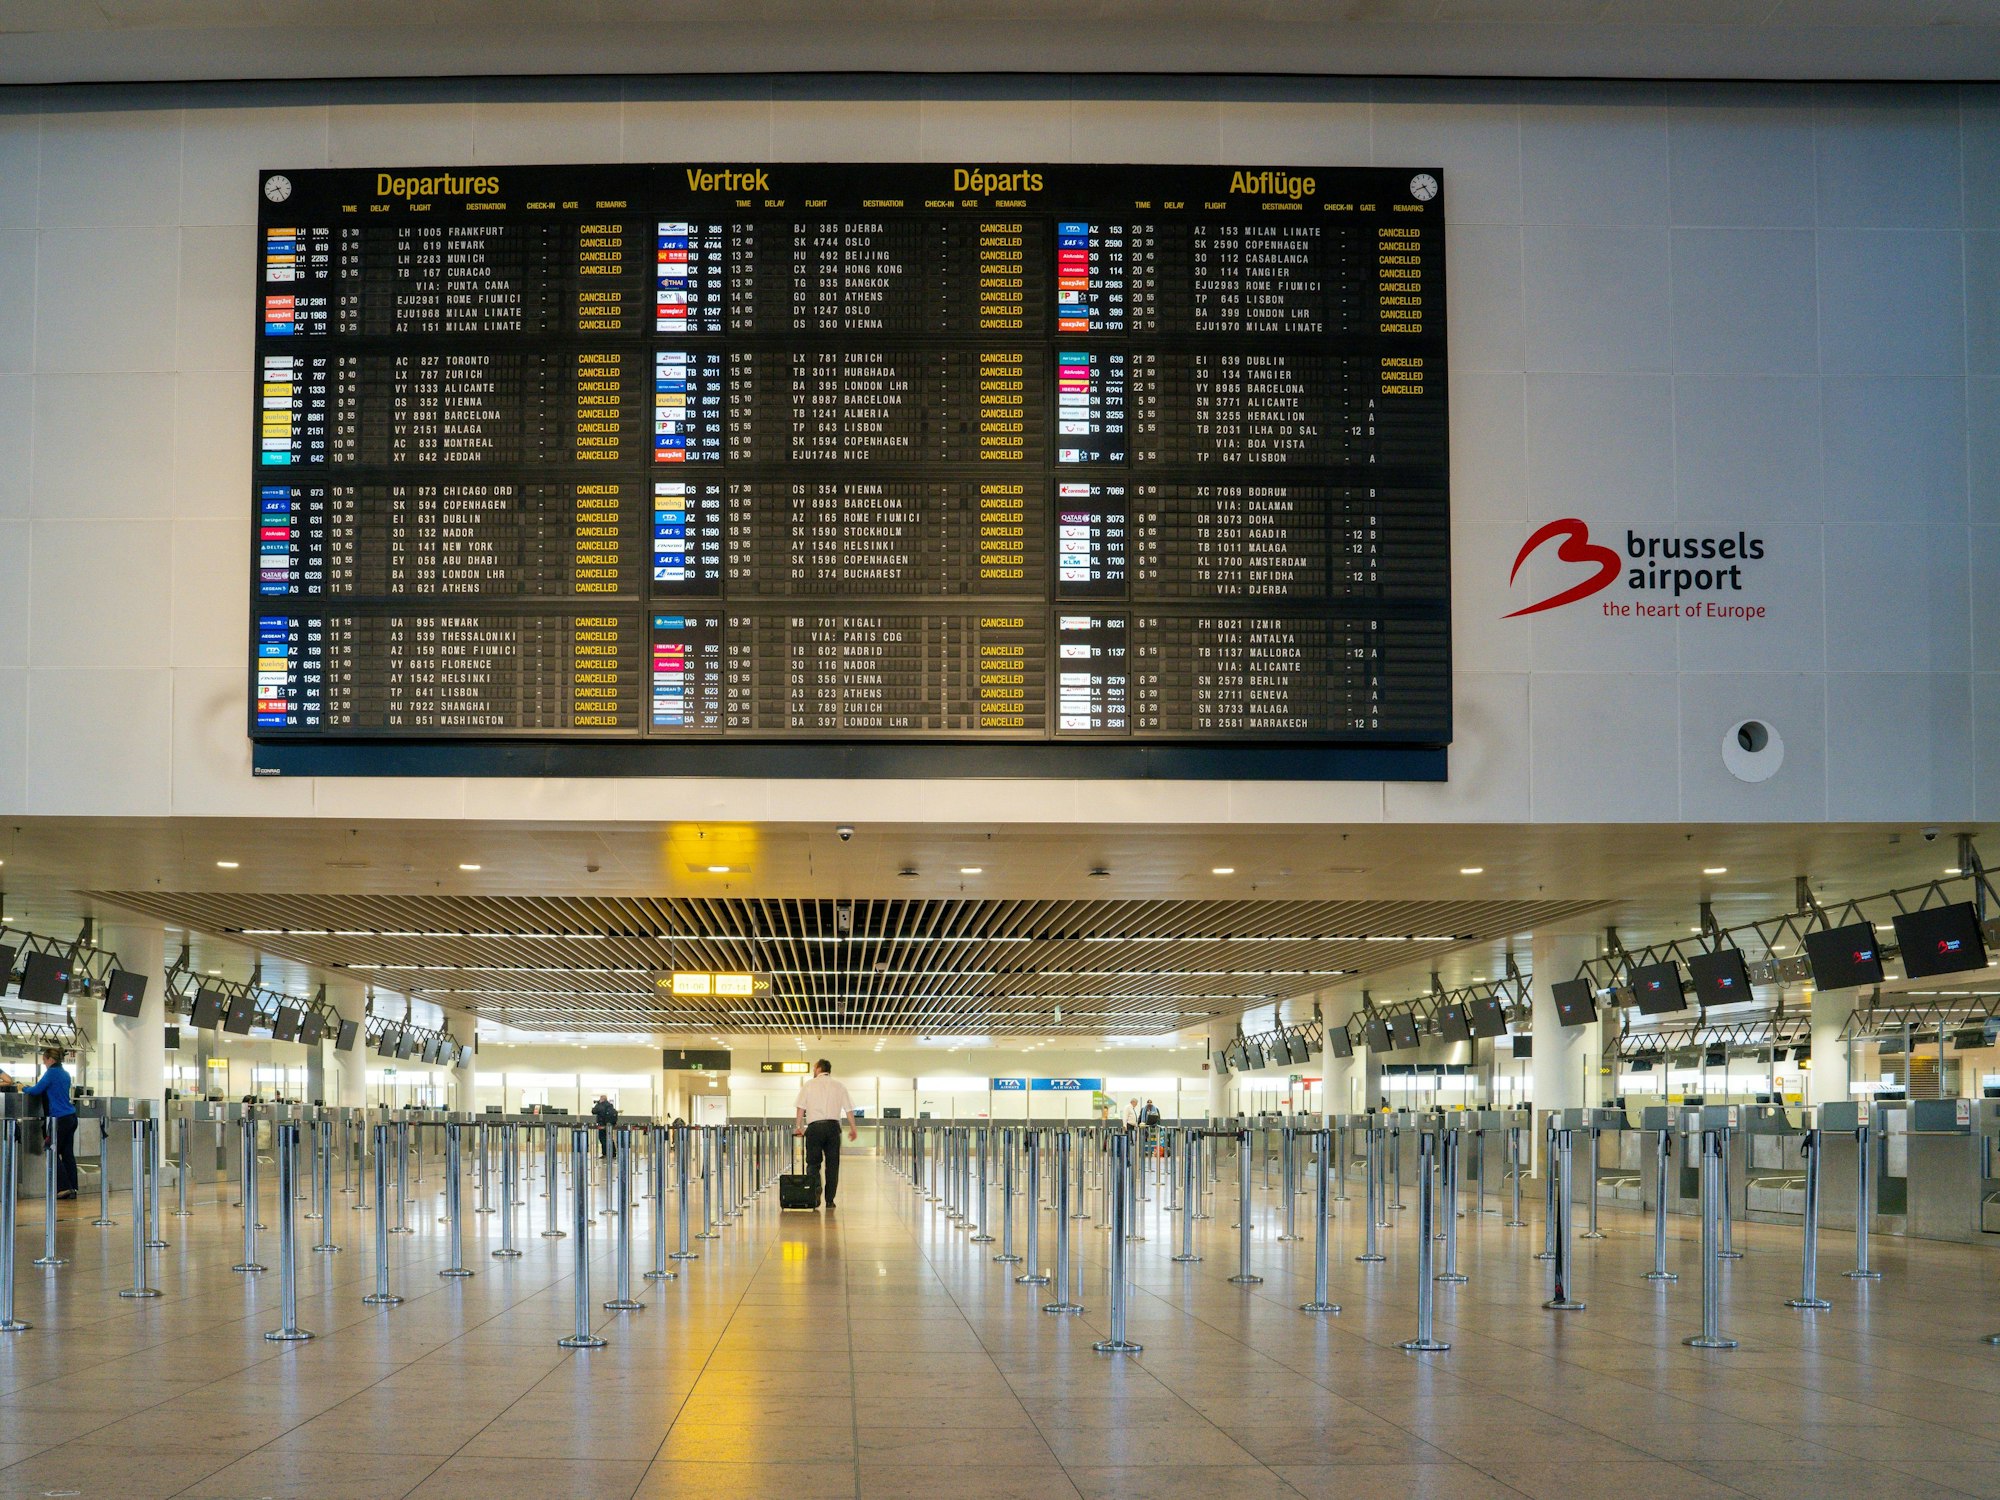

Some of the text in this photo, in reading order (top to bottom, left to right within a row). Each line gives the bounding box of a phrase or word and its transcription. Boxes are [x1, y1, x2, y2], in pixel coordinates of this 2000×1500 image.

[687, 169, 769, 191] Vertrek
[954, 169, 1043, 196] Départs
[378, 173, 499, 200] Departures
[1230, 171, 1315, 199] Abflüge
[399, 225, 622, 237] LH 1005 FRANKFURT CANCELLED
[820, 224, 1022, 233] 385 DJERBA CANCELLED
[1245, 227, 1420, 237] MILAN LINATE CANCELLED
[448, 241, 484, 249] NEWARK
[1195, 240, 1308, 249] SK 2590 COPENHAGEN
[448, 254, 484, 263] MUNICH
[846, 251, 889, 260] BEIJING
[1246, 254, 1308, 263] CASABLANCA
[448, 267, 490, 276] CURACAO
[845, 265, 902, 273] HONG KONG
[1246, 268, 1289, 276] TANGIER
[448, 281, 509, 290] PUNTA CANA
[845, 279, 889, 287] BANGKOK
[1246, 281, 1320, 291] ROME FIUMICI
[398, 293, 621, 304] EJU2981 ROME FIUMICI CANCELLED
[845, 292, 1022, 301] ATHENS CANCELLED
[1247, 295, 1283, 304] LISBON
[794, 306, 870, 314] DY 1247 OSLO
[1247, 309, 1422, 319] LONDON LHR CANCELLED
[845, 320, 882, 328] VIENNA
[421, 354, 620, 365] 827 TORONTO CANCELLED
[819, 354, 882, 362] 781 ZURICH
[1222, 356, 1423, 367] 639 DUBLIN CANCELLED
[446, 370, 482, 379] ZURICH
[845, 368, 895, 376] HURGHADA
[266, 386, 290, 394] vueling
[445, 384, 494, 392] ALICANTE
[845, 381, 908, 390] LONDON LHR
[1248, 384, 1304, 393] BARCELONA
[845, 395, 901, 404] BARCELONA
[445, 411, 500, 420] BARCELONA
[845, 409, 888, 418] ALMERIA
[1248, 412, 1304, 421] HERAKLION
[445, 425, 481, 433] MALAGA
[444, 439, 493, 447] MONTREAL
[1248, 439, 1304, 448] BOA VISTA
[444, 452, 480, 461] JEDDAH
[793, 451, 1023, 459] EJU1748 NICE CANCELLED
[444, 485, 619, 495] CHICAGO ORD CANCELLED
[1217, 487, 1286, 496] 7069 BODRUM
[444, 501, 506, 509] COPENHAGEN
[1249, 502, 1293, 510] DALAMAN
[793, 527, 901, 536] SK 1590 STOCKHOLM
[443, 542, 492, 551] NEW YORK
[844, 541, 893, 550] HELSINKI
[1628, 530, 1764, 559] brussels
[443, 556, 497, 564] ABU DHABI
[1249, 557, 1306, 566] AMSTERDAM
[844, 569, 901, 578] BUCHAREST
[1250, 571, 1293, 580] ENFIDHA
[1628, 562, 1742, 596] airport
[442, 584, 479, 592] ATHENS
[1603, 602, 1765, 621] the heart of Europe
[819, 618, 1023, 627] 701 KIGALI CANCELLED
[1218, 620, 1280, 629] 8021 IZMIR
[442, 632, 515, 641] THESSALONIKI
[844, 632, 901, 641] PARIS CDG
[1250, 634, 1294, 643] ANTALYA
[844, 647, 882, 655] MADRID
[1250, 648, 1300, 657] MALLORCA
[442, 660, 491, 668] FLORENCE
[441, 702, 489, 710] SHANGHAI
[1250, 704, 1288, 713] MALAGA
[441, 716, 617, 725] WASHINGTON CANCELLED
[844, 717, 882, 726] LONDON
[1250, 719, 1307, 727] MARRAKECH
